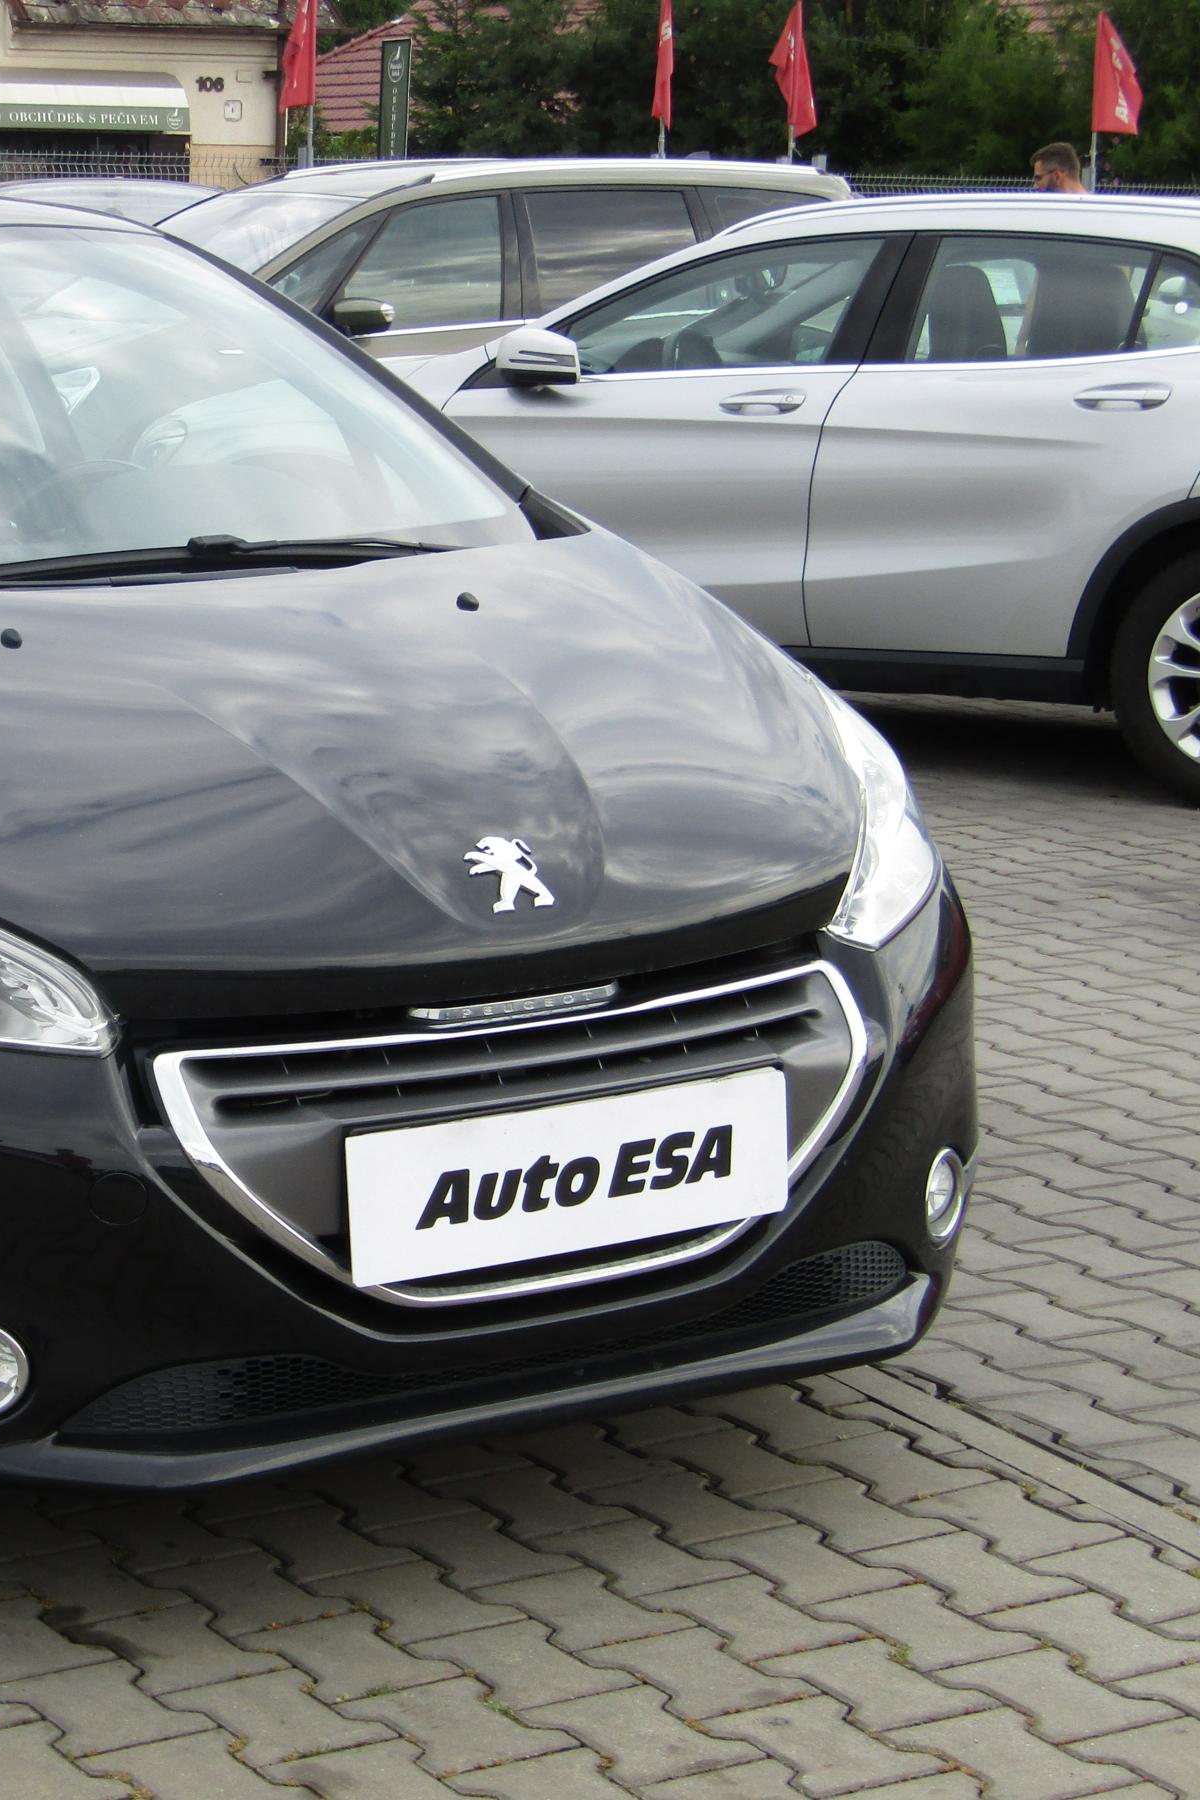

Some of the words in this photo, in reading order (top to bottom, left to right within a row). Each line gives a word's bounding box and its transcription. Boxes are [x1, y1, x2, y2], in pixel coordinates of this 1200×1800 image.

[195, 76, 225, 93] 106
[9, 109, 86, 124] OBCHŮDEK
[88, 113, 97, 124] S
[100, 112, 159, 126] PEČIVEM
[462, 991, 593, 1018] PEUGEOT
[415, 1154, 600, 1231] Auto
[607, 1124, 733, 1199] ESA
